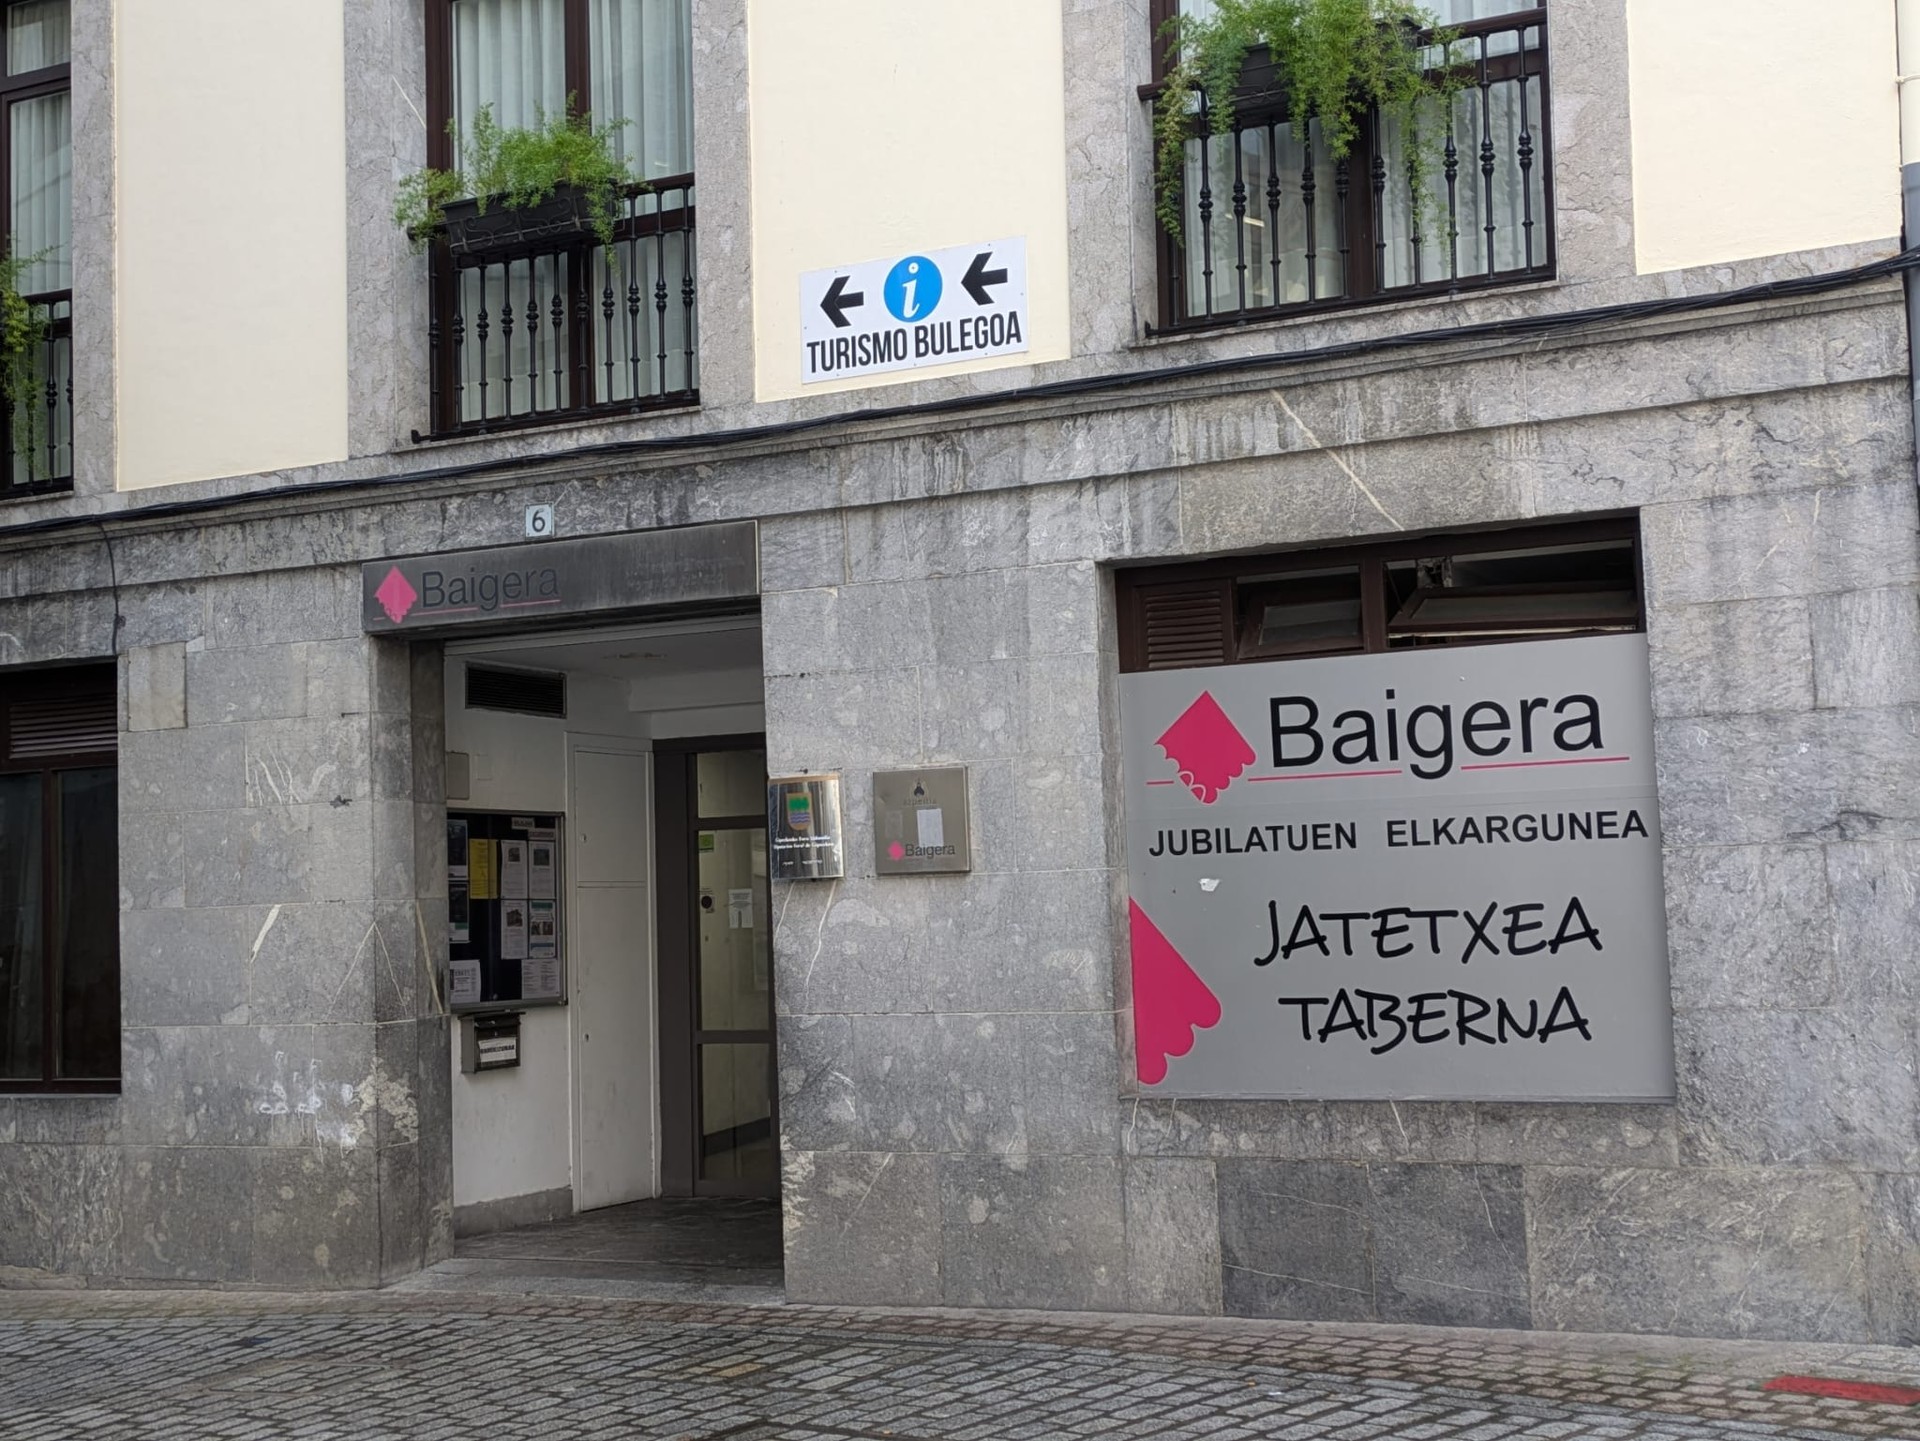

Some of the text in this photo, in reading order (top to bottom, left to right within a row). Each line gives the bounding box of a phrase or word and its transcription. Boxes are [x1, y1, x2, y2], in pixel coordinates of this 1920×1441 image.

[806, 310, 1022, 374] TURISMO BULEGOA
[531, 509, 546, 534] 6
[422, 566, 559, 612] Baigera
[1269, 688, 1604, 780] Baigera
[905, 843, 955, 859] Baigera
[1149, 809, 1649, 857] JUBILATUEN ELKARGUNEA
[1254, 896, 1603, 967] JATETXEA
[1278, 986, 1593, 1055] TABERNA
